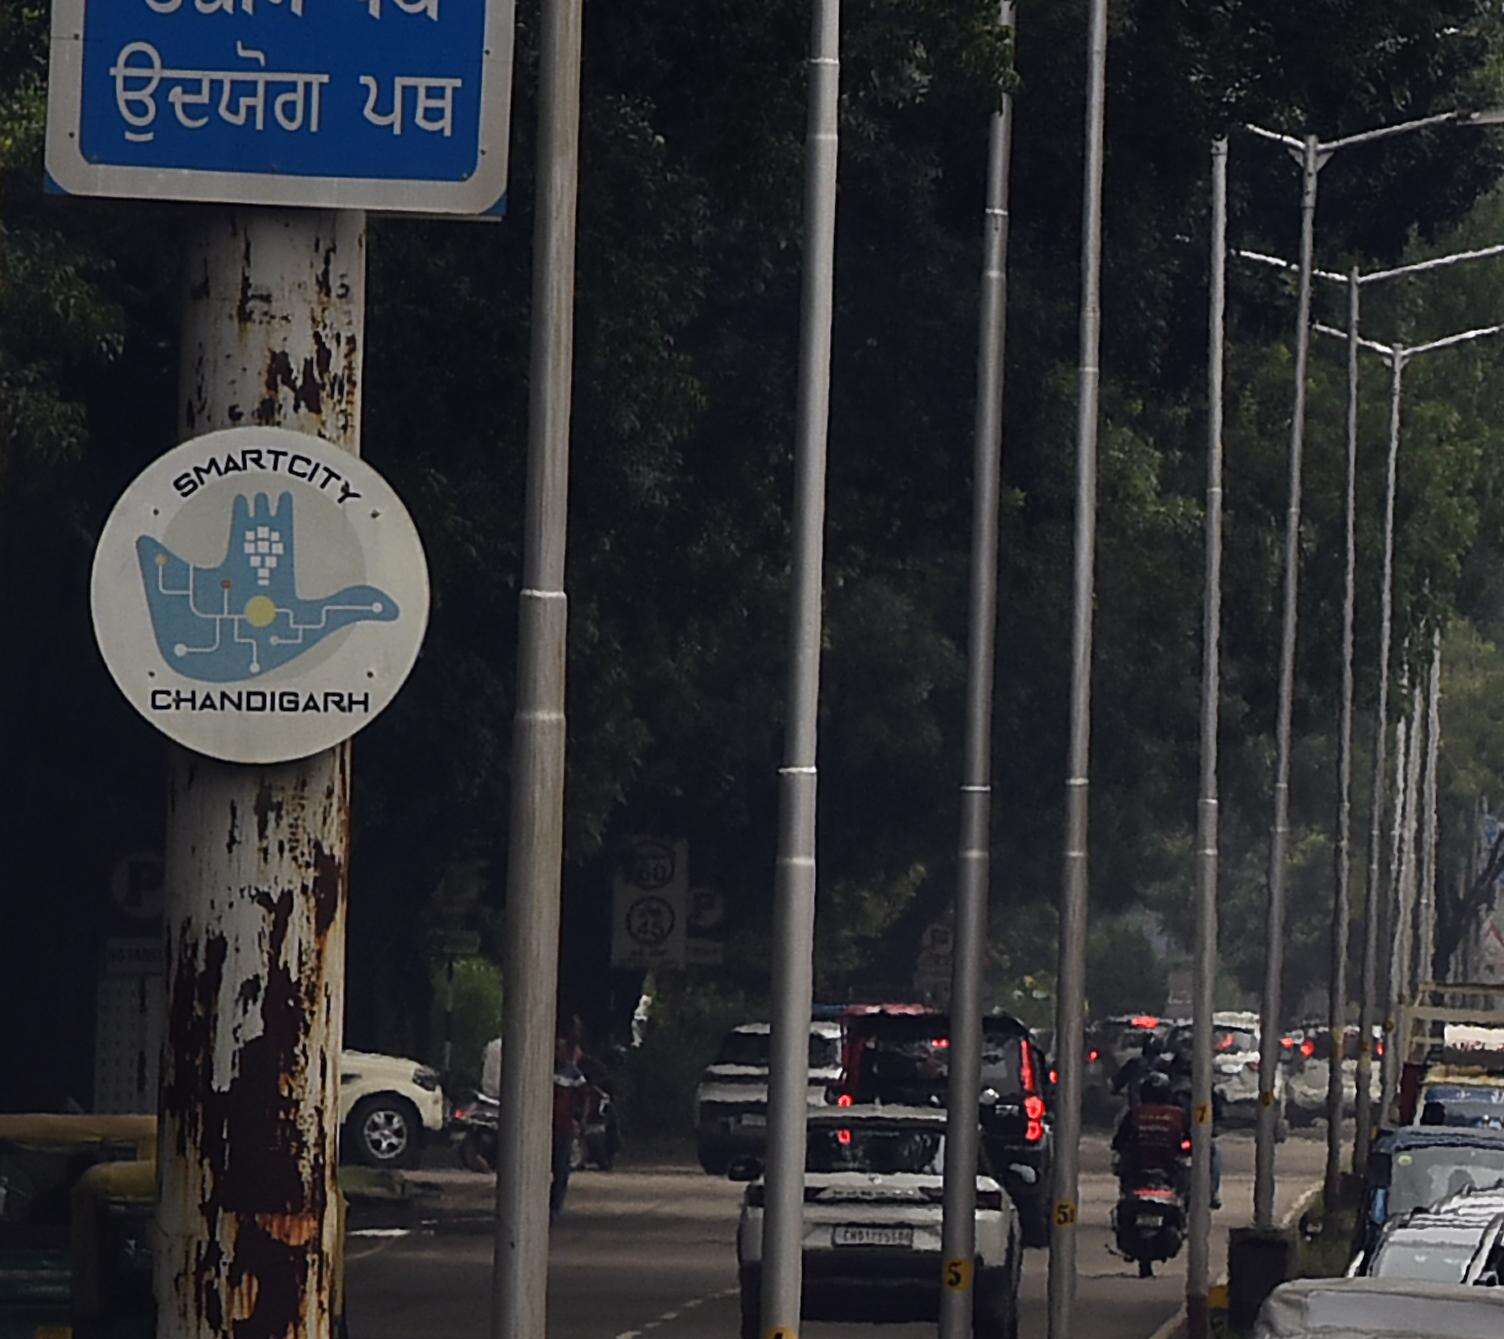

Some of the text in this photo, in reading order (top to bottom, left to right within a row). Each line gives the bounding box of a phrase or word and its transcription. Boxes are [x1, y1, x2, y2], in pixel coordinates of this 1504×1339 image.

[109, 41, 463, 142] ਉਦਯੋਗ ਪਥ
[150, 689, 370, 713] CHANDIGARH
[947, 1260, 963, 1287] 5
